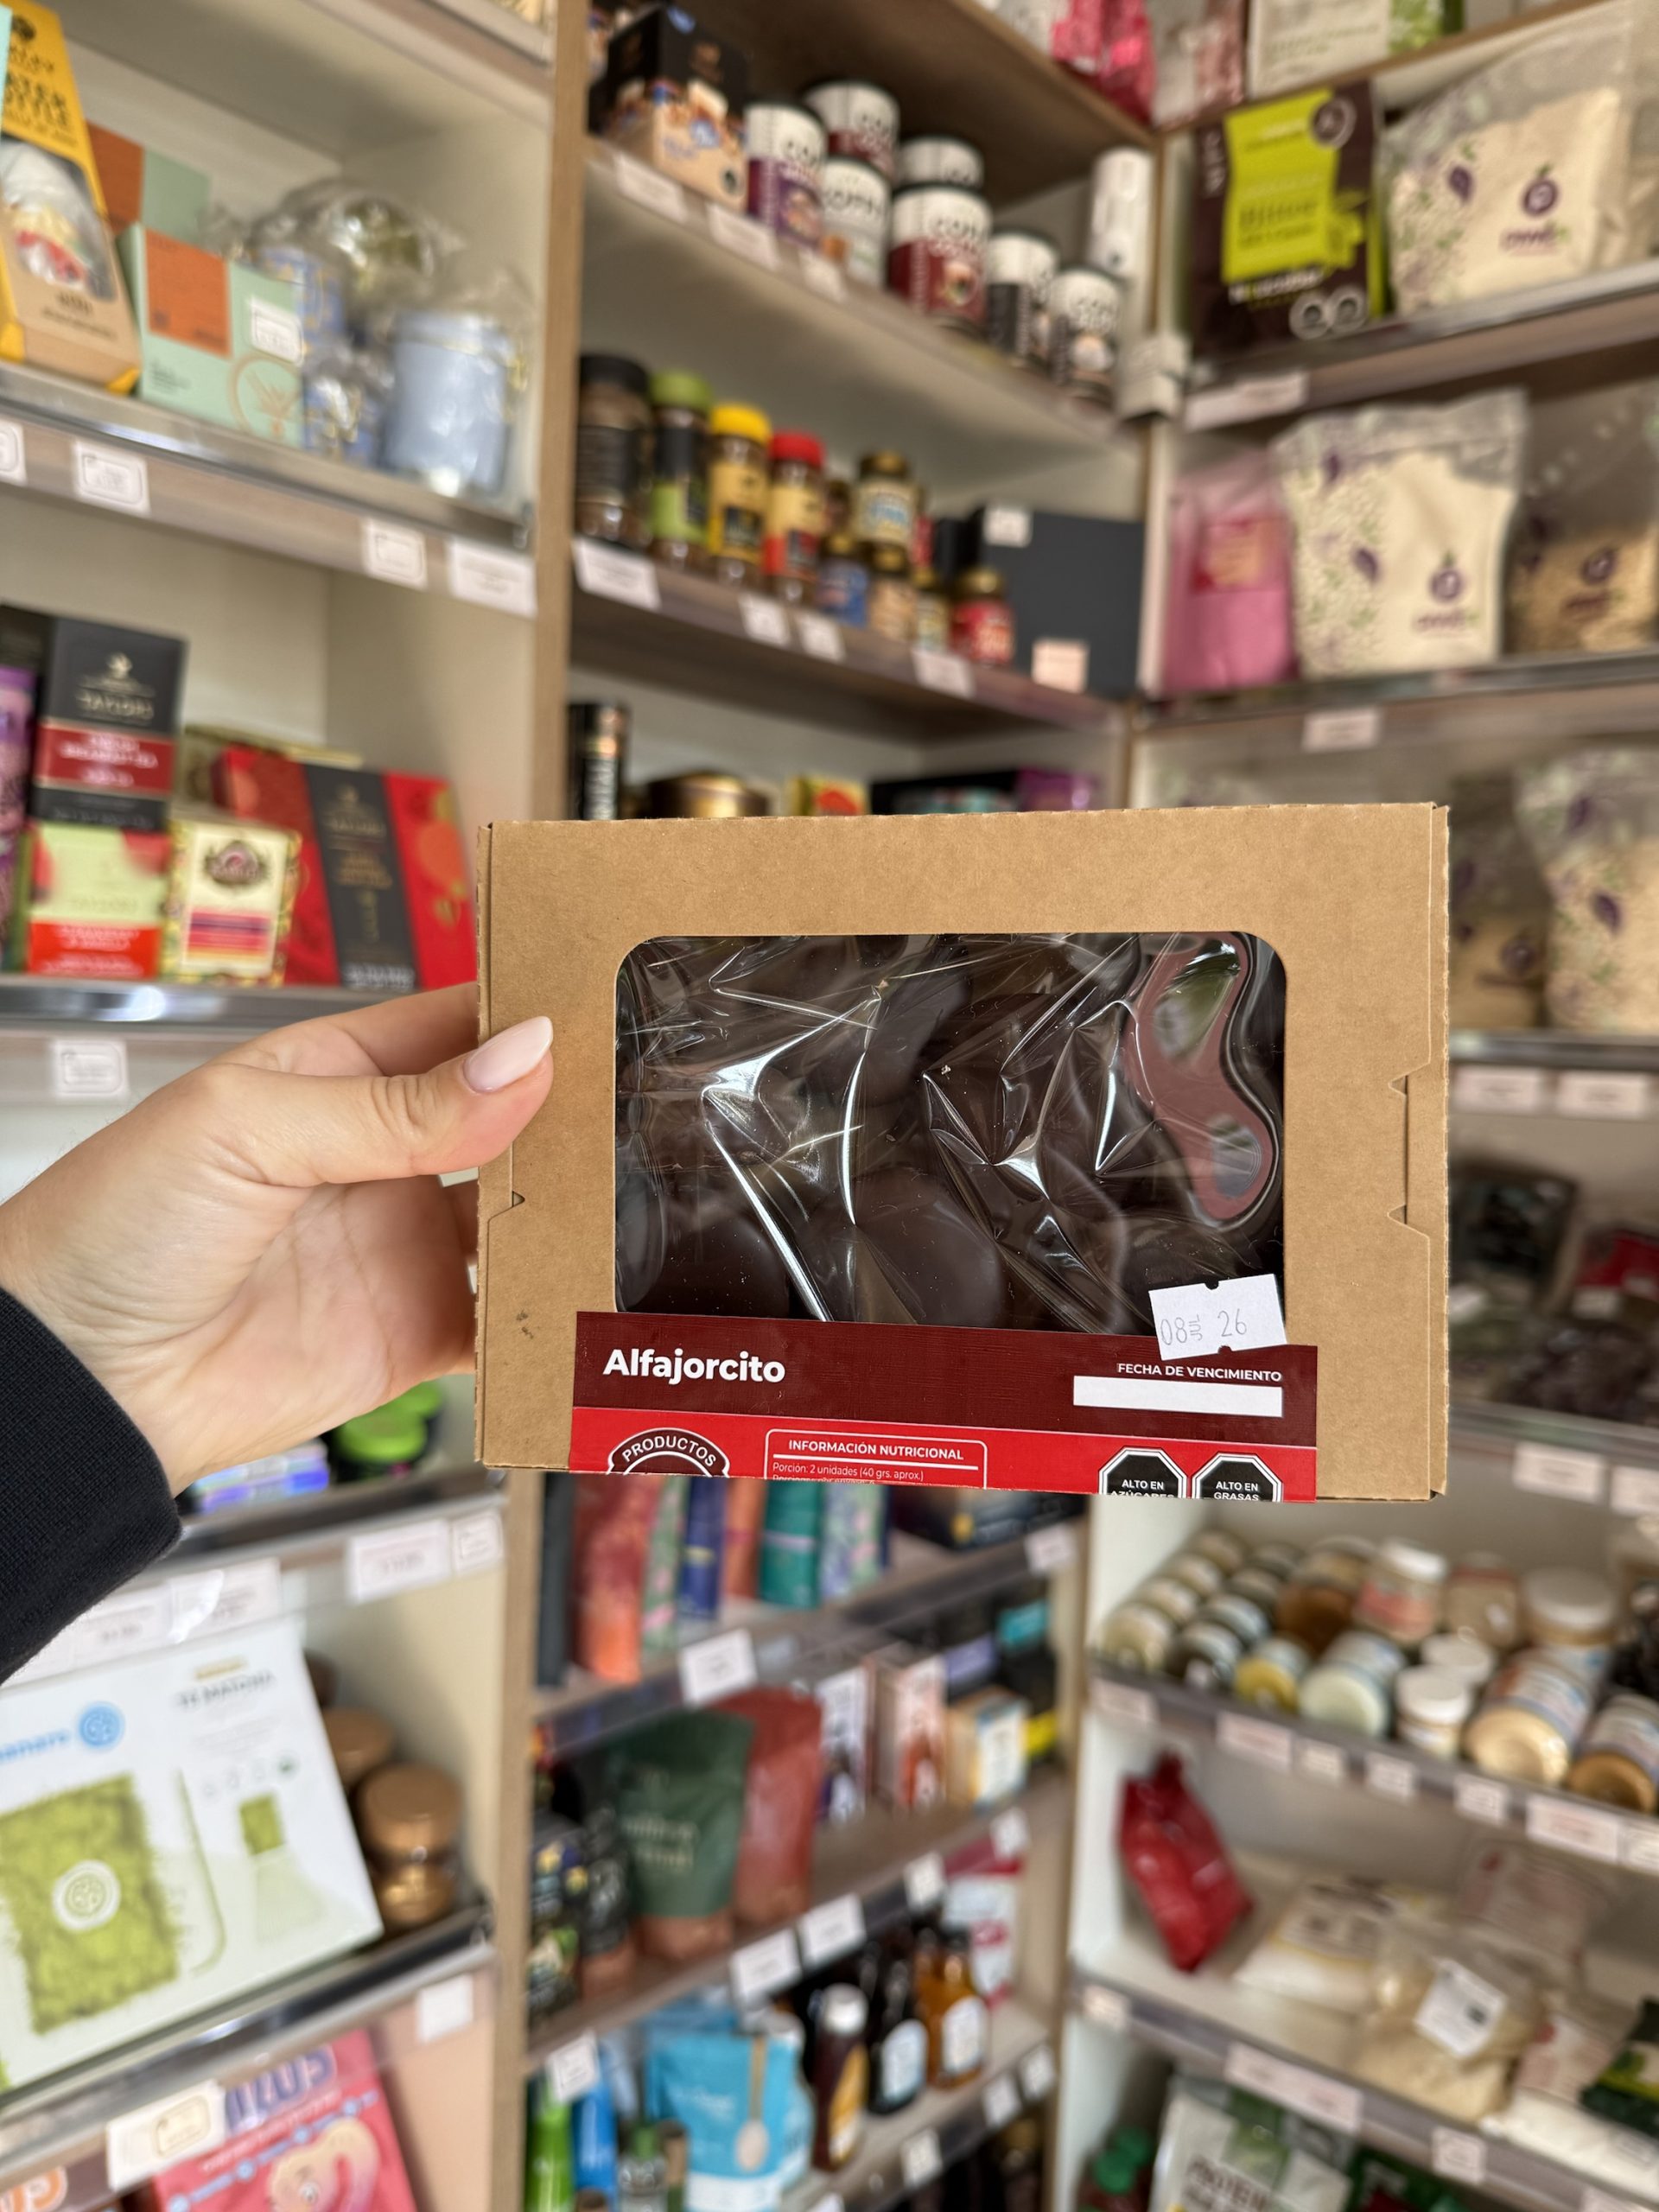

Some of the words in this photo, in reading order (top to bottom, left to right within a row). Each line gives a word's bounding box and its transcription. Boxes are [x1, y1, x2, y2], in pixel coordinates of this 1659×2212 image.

[1160, 1317, 1188, 1346] 08
[1217, 1307, 1248, 1338] 26
[602, 1347, 786, 1385] Alfajorcito
[1117, 1363, 1163, 1376] FECHA
[1165, 1365, 1185, 1376] DE
[1186, 1366, 1282, 1382] VENCIMIENTO
[621, 1435, 717, 1467] PRODUCTOS
[788, 1439, 877, 1455] INFORMACIÓN
[879, 1445, 964, 1460] NUTRICIONAL
[772, 1461, 809, 1473] Porción:
[809, 1464, 817, 1474] 2
[817, 1465, 858, 1477] unidades
[859, 1466, 874, 1478] (40
[875, 1470, 893, 1480] grs.
[893, 1471, 925, 1482] aprox.)
[1121, 1478, 1148, 1489] ALTO
[1150, 1480, 1165, 1491] EN
[1215, 1480, 1243, 1491] ALTO
[1244, 1482, 1259, 1491] EN
[1213, 1491, 1260, 1501] GRASAS
